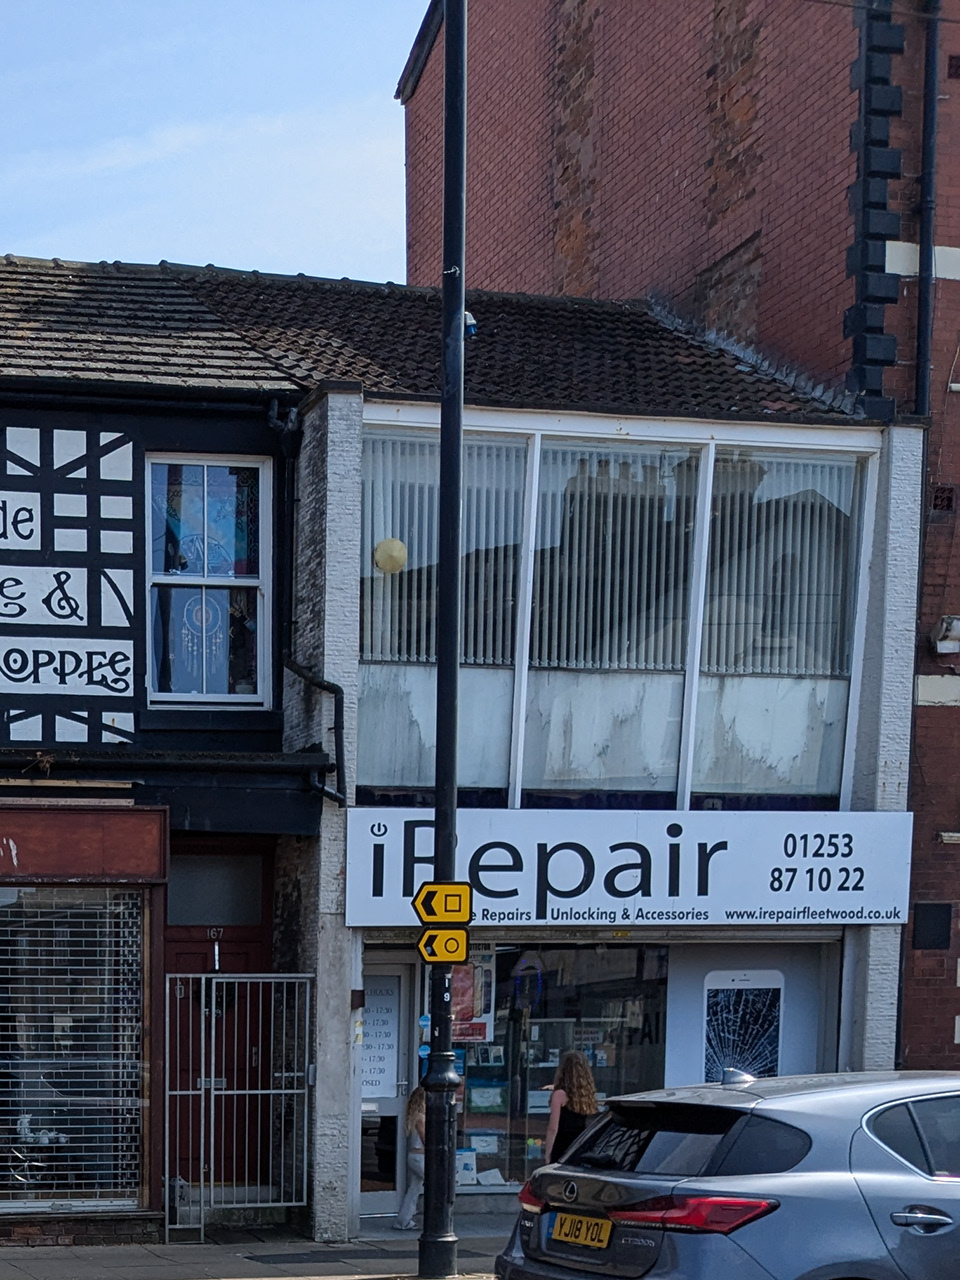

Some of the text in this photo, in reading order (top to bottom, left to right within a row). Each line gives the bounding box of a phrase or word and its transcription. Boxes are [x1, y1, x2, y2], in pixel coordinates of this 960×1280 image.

[41, 570, 85, 622] &
[783, 833, 854, 858] 01253
[769, 867, 798, 892] 87
[481, 908, 532, 924] Repairs
[550, 908, 617, 924] Unlocking
[620, 908, 631, 921] &
[635, 908, 710, 921] Accessories
[725, 906, 901, 923] www.irepairfleetwood.co.uk
[206, 928, 224, 940] 167
[584, 1221, 604, 1243] YOL
